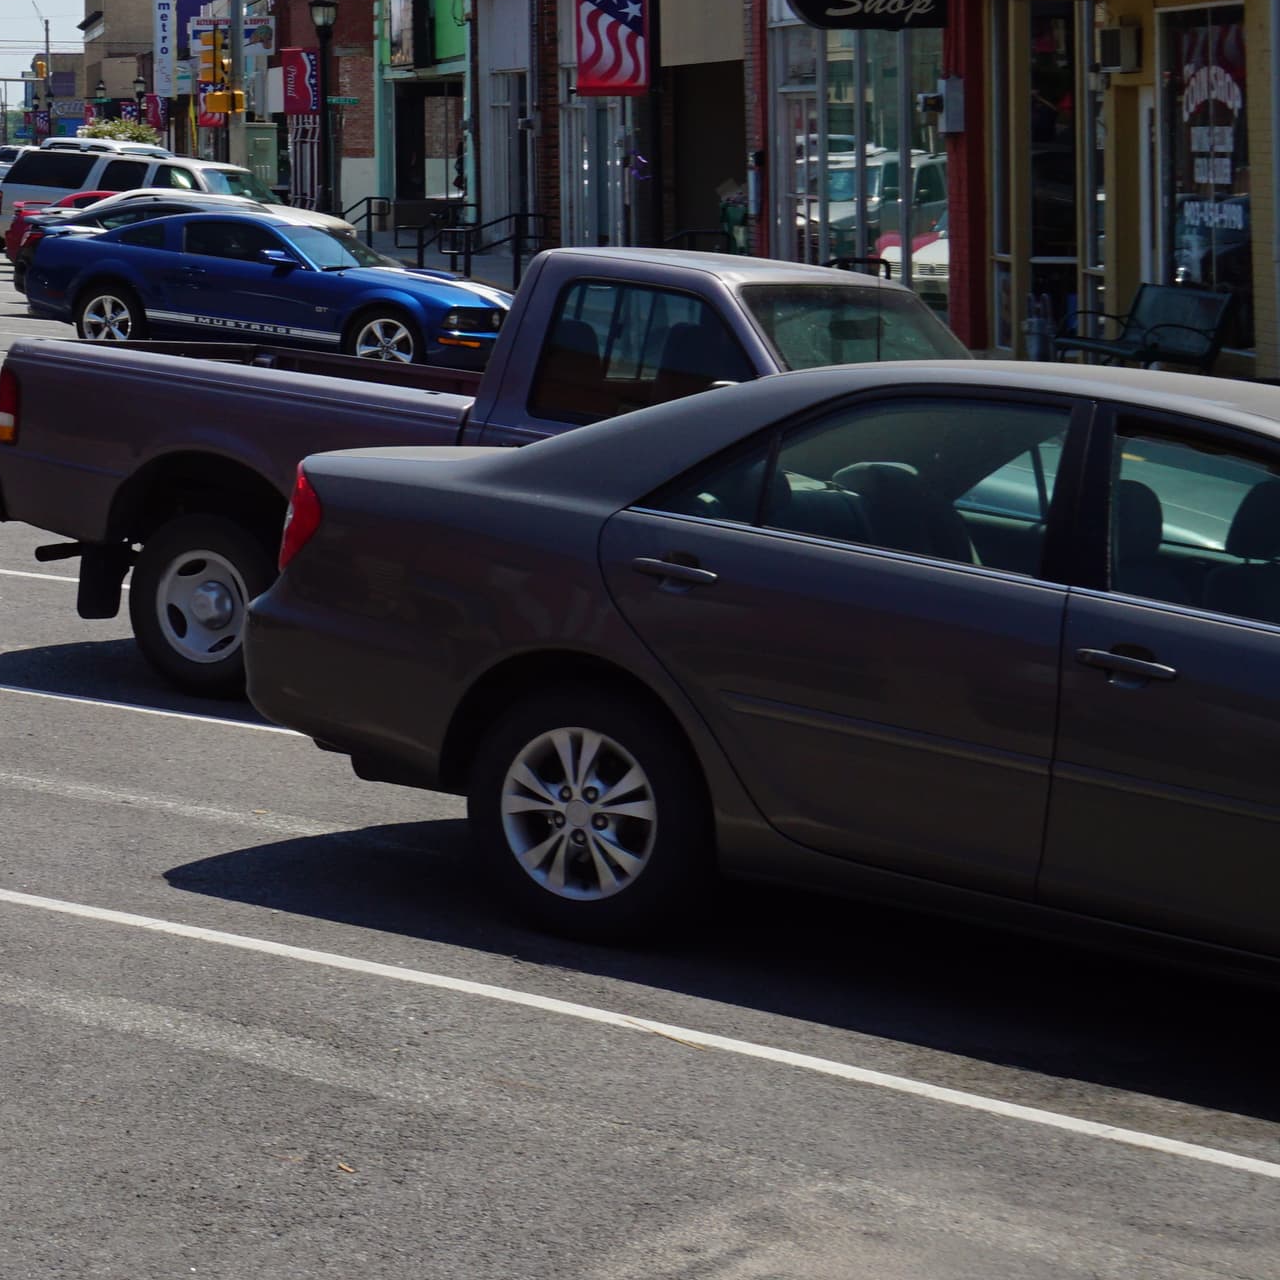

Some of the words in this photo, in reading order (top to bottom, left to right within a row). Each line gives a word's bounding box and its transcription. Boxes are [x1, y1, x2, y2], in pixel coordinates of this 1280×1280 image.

[157, 2, 170, 55] metro
[287, 64, 299, 99] Proud
[1209, 65, 1242, 118] SHOP
[198, 317, 288, 334] MUSTANG
